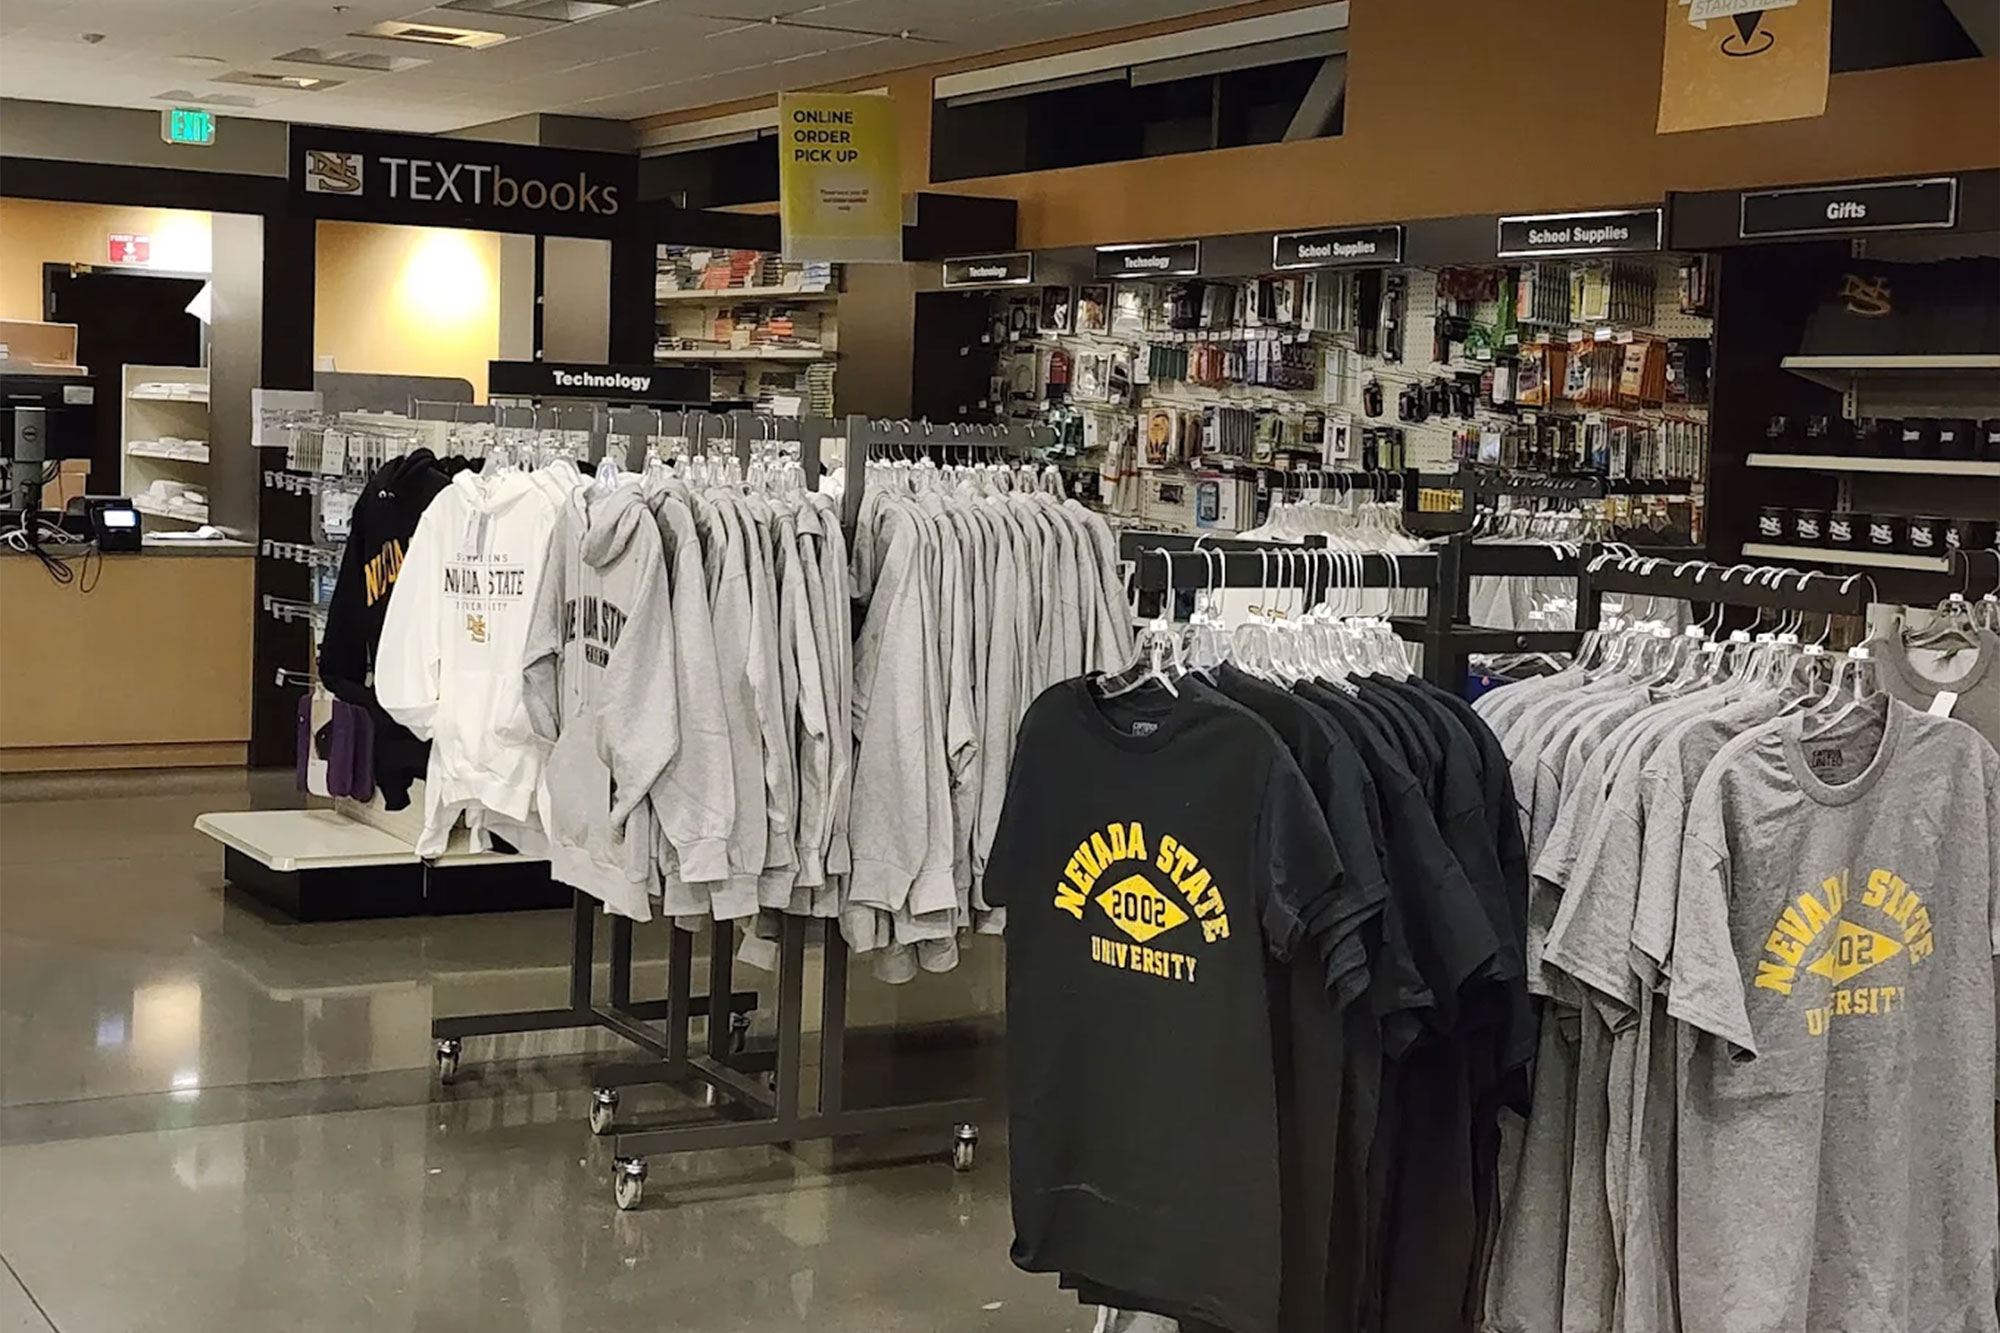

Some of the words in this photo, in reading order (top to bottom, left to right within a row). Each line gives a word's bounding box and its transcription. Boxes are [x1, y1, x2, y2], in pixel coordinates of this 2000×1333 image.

[172, 111, 208, 141] EXIT
[793, 110, 854, 124] ONLINE
[793, 130, 851, 143] ORDER
[794, 149, 832, 162] PICK
[836, 150, 858, 162] UP
[379, 156, 619, 215] TEXTbooks
[1826, 202, 1866, 219] Gifts
[1528, 228, 1570, 244] School
[1573, 226, 1628, 243] Supplies
[1298, 243, 1331, 258] School
[1333, 241, 1376, 257] Supplies
[1124, 256, 1170, 269] Technology
[969, 266, 1008, 278] Technology
[552, 370, 651, 391] Technology
[1054, 822, 1147, 920] NEVADA
[1156, 834, 1231, 943] STATE
[1112, 889, 1166, 928] 2002
[1755, 867, 1849, 995] NEVAD
[1091, 935, 1198, 983] UNIVERSITY
